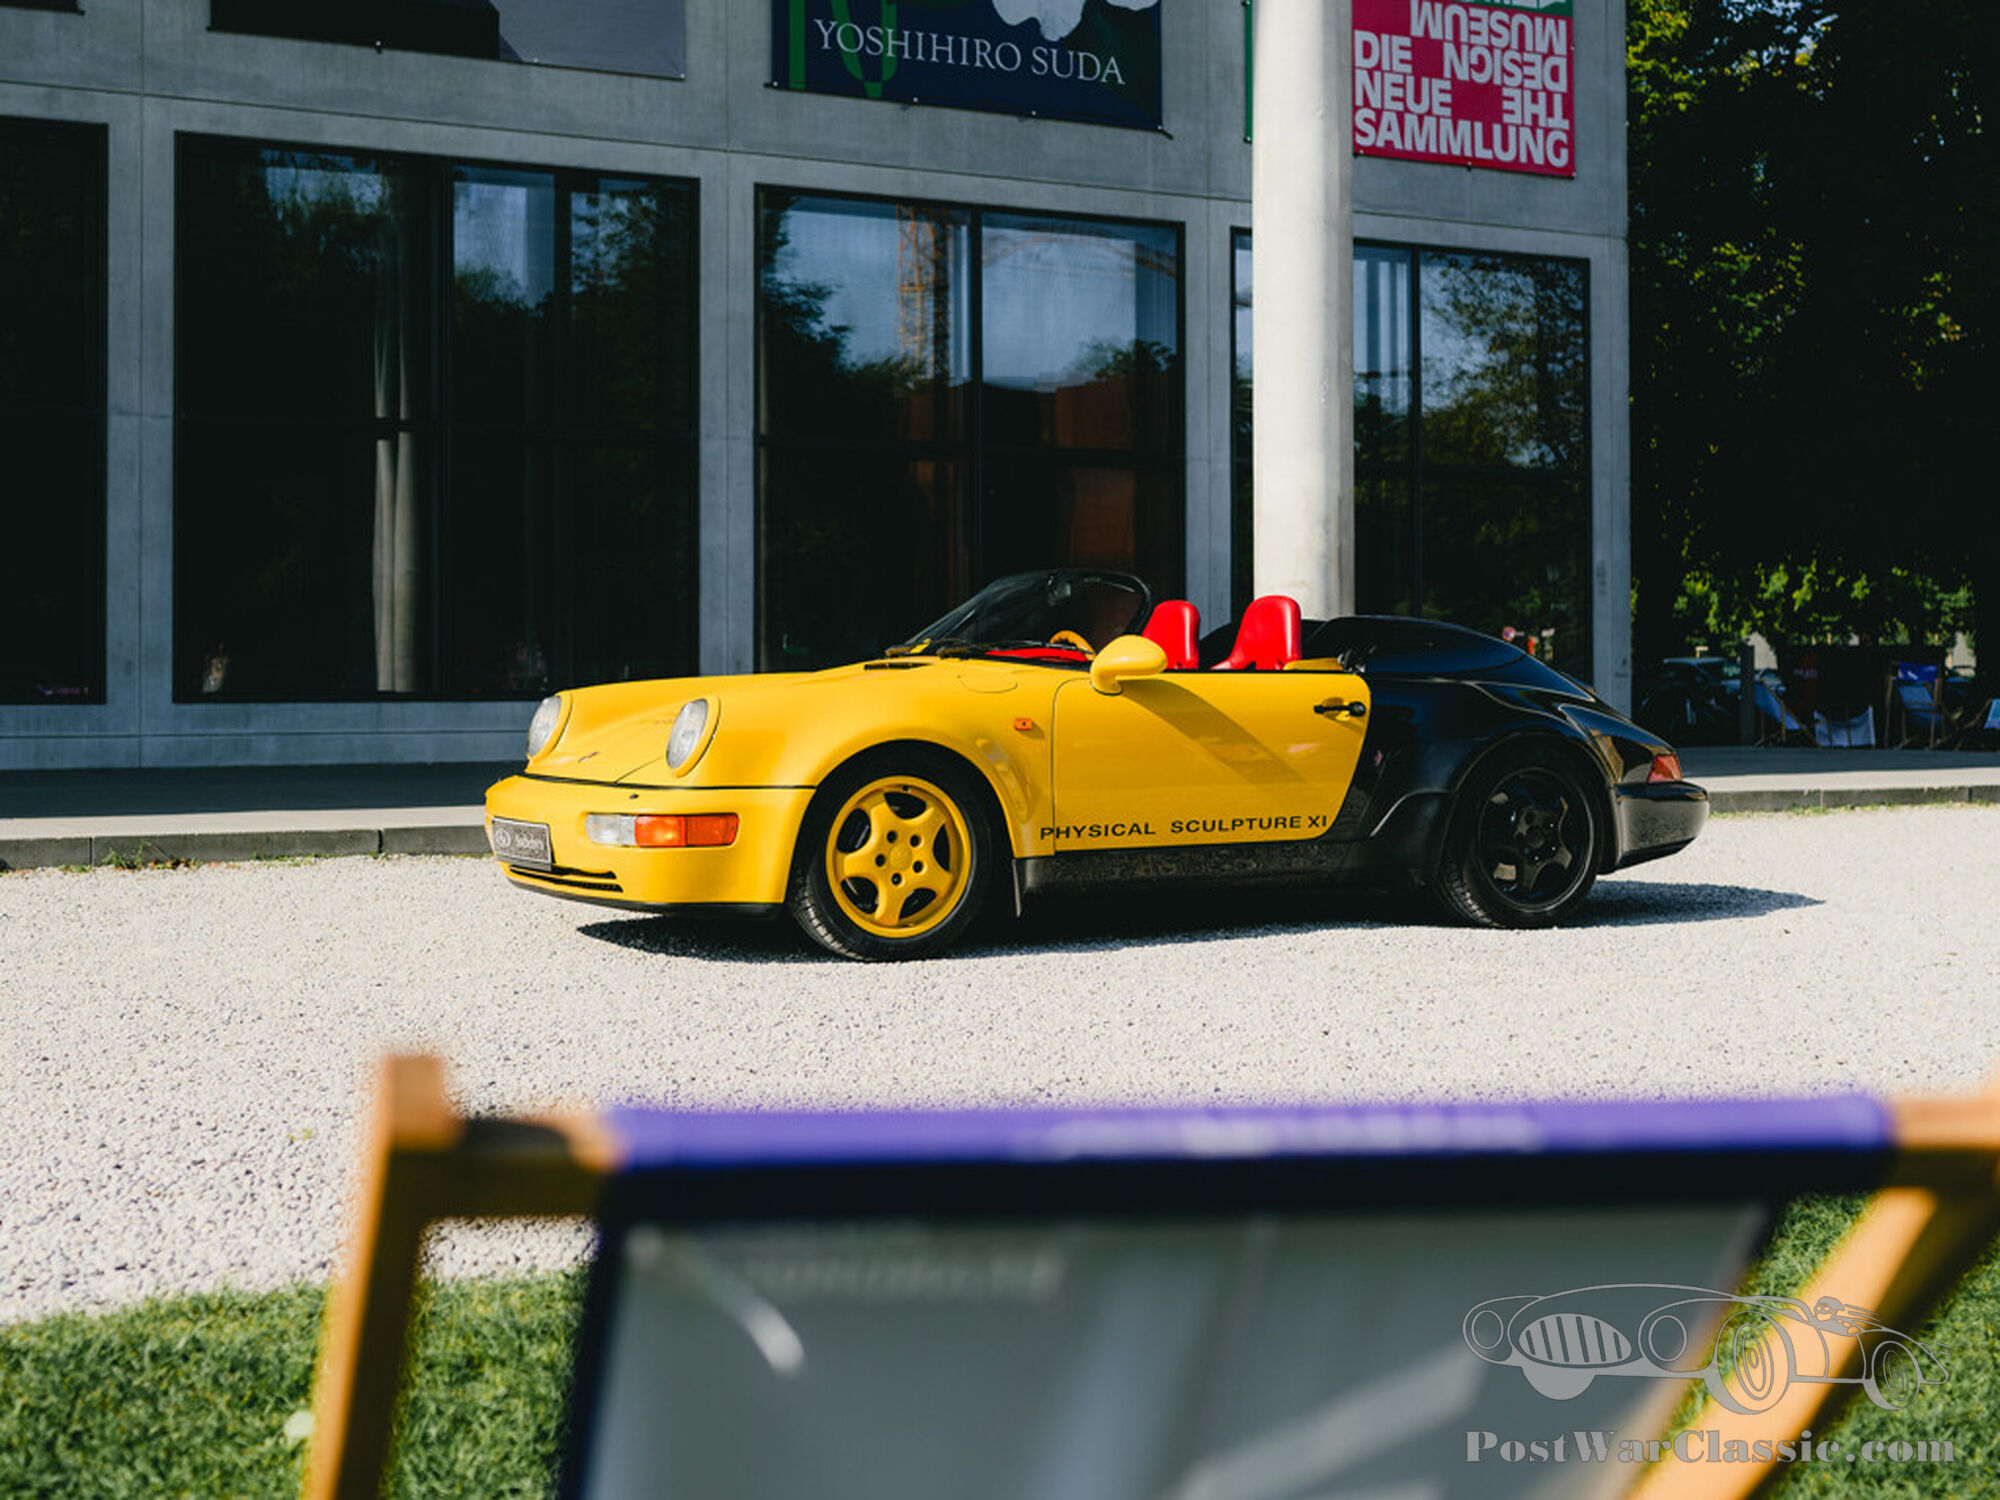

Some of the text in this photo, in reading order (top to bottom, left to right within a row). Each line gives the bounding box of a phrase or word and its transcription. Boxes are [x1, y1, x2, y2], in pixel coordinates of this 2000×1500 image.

[814, 19, 1126, 86] YOSHIHIRO SUDA
[1354, 29, 1412, 74] DIE
[1410, 0, 1567, 56] MUSEUM
[1443, 42, 1567, 93] DESIGN
[1355, 69, 1452, 117] NEUE
[1502, 88, 1570, 131] THE
[1354, 111, 1569, 169] SAMMLUNG
[1040, 815, 1327, 841] PHYSICAL SCULPTURE XI
